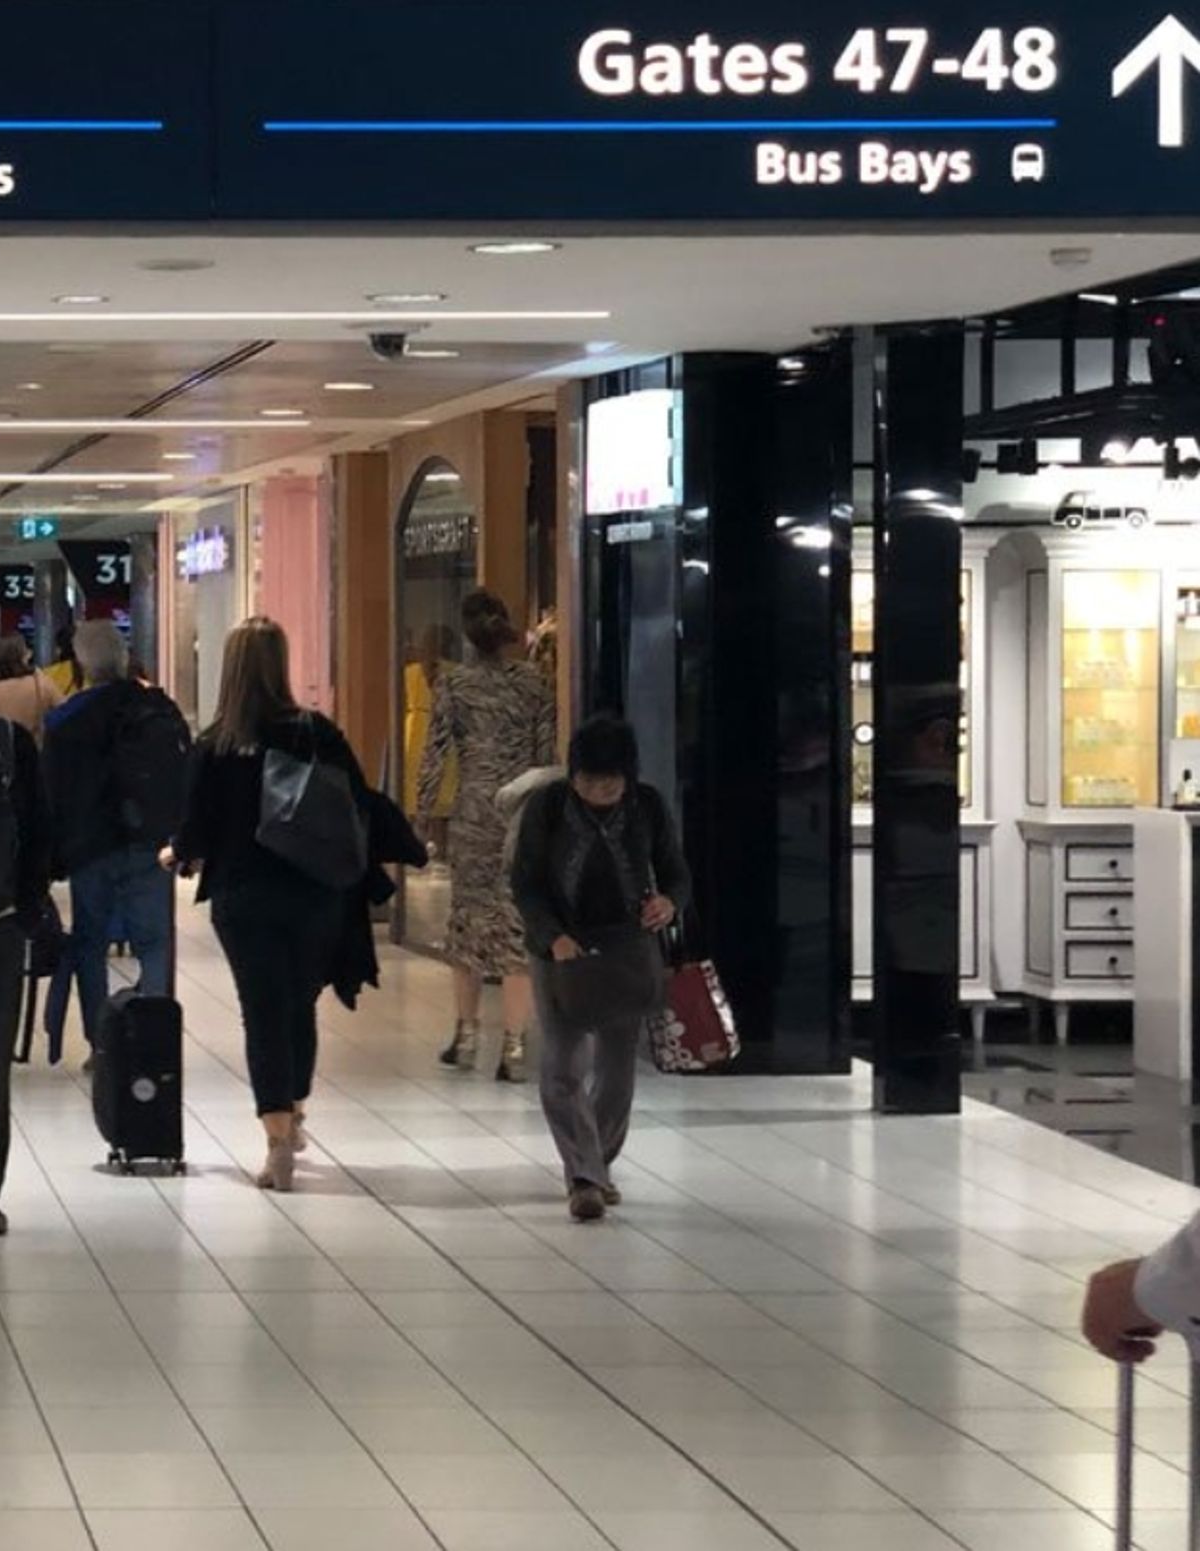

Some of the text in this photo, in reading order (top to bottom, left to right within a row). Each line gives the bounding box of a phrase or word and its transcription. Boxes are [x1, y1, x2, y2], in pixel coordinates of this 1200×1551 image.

[578, 26, 1059, 96] Gates 47-48
[756, 141, 972, 195] Bus Bays
[4, 574, 36, 599] 33
[95, 553, 134, 585] 31
